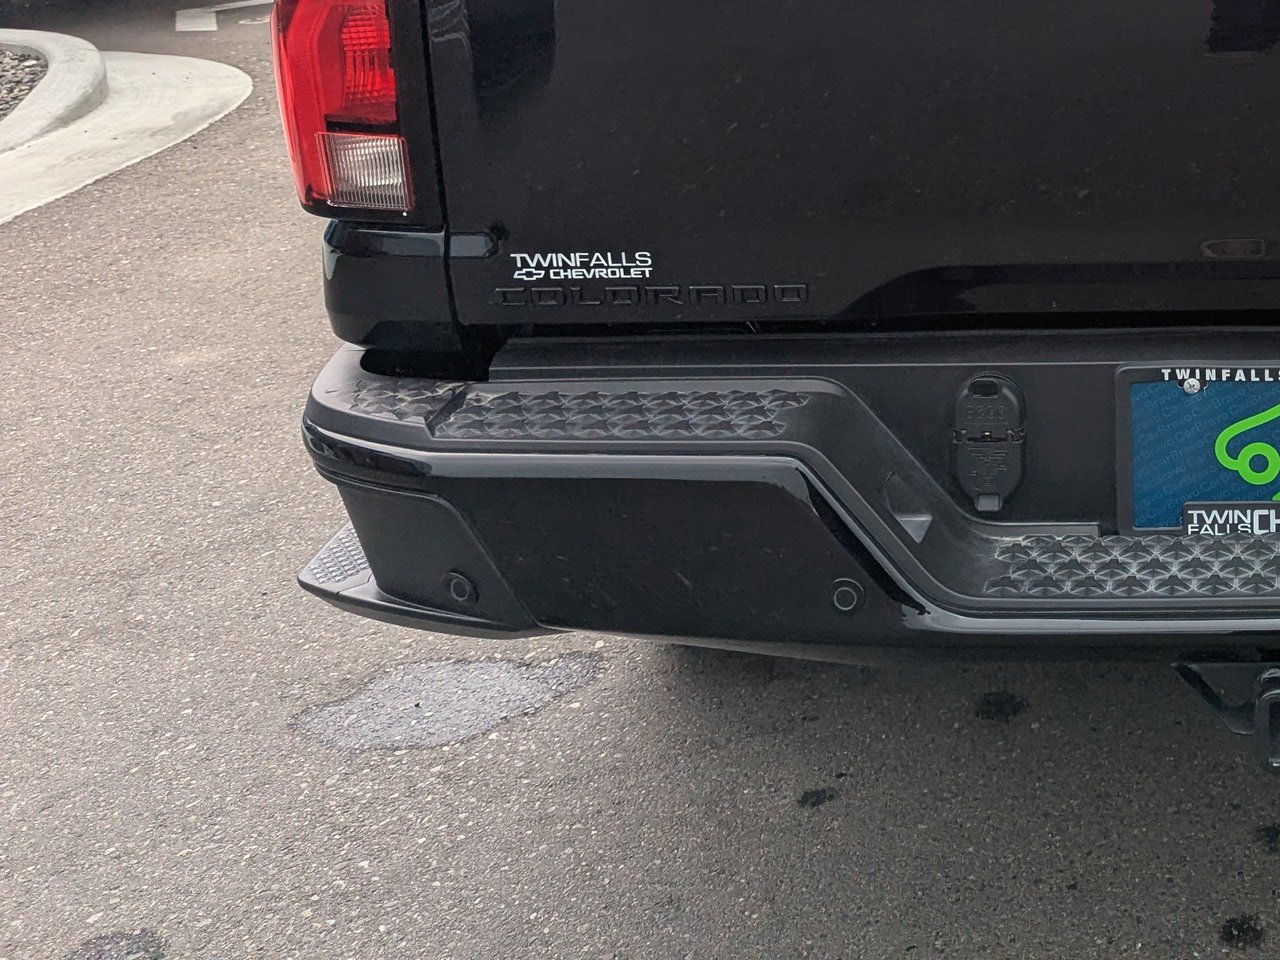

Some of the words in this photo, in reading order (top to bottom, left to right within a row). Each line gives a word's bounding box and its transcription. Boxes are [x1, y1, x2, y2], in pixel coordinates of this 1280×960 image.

[510, 252, 652, 268] TWINFALLS
[549, 267, 653, 280] CHEVROLET
[495, 283, 809, 306] COLORADO
[1187, 509, 1251, 524] TWIN
